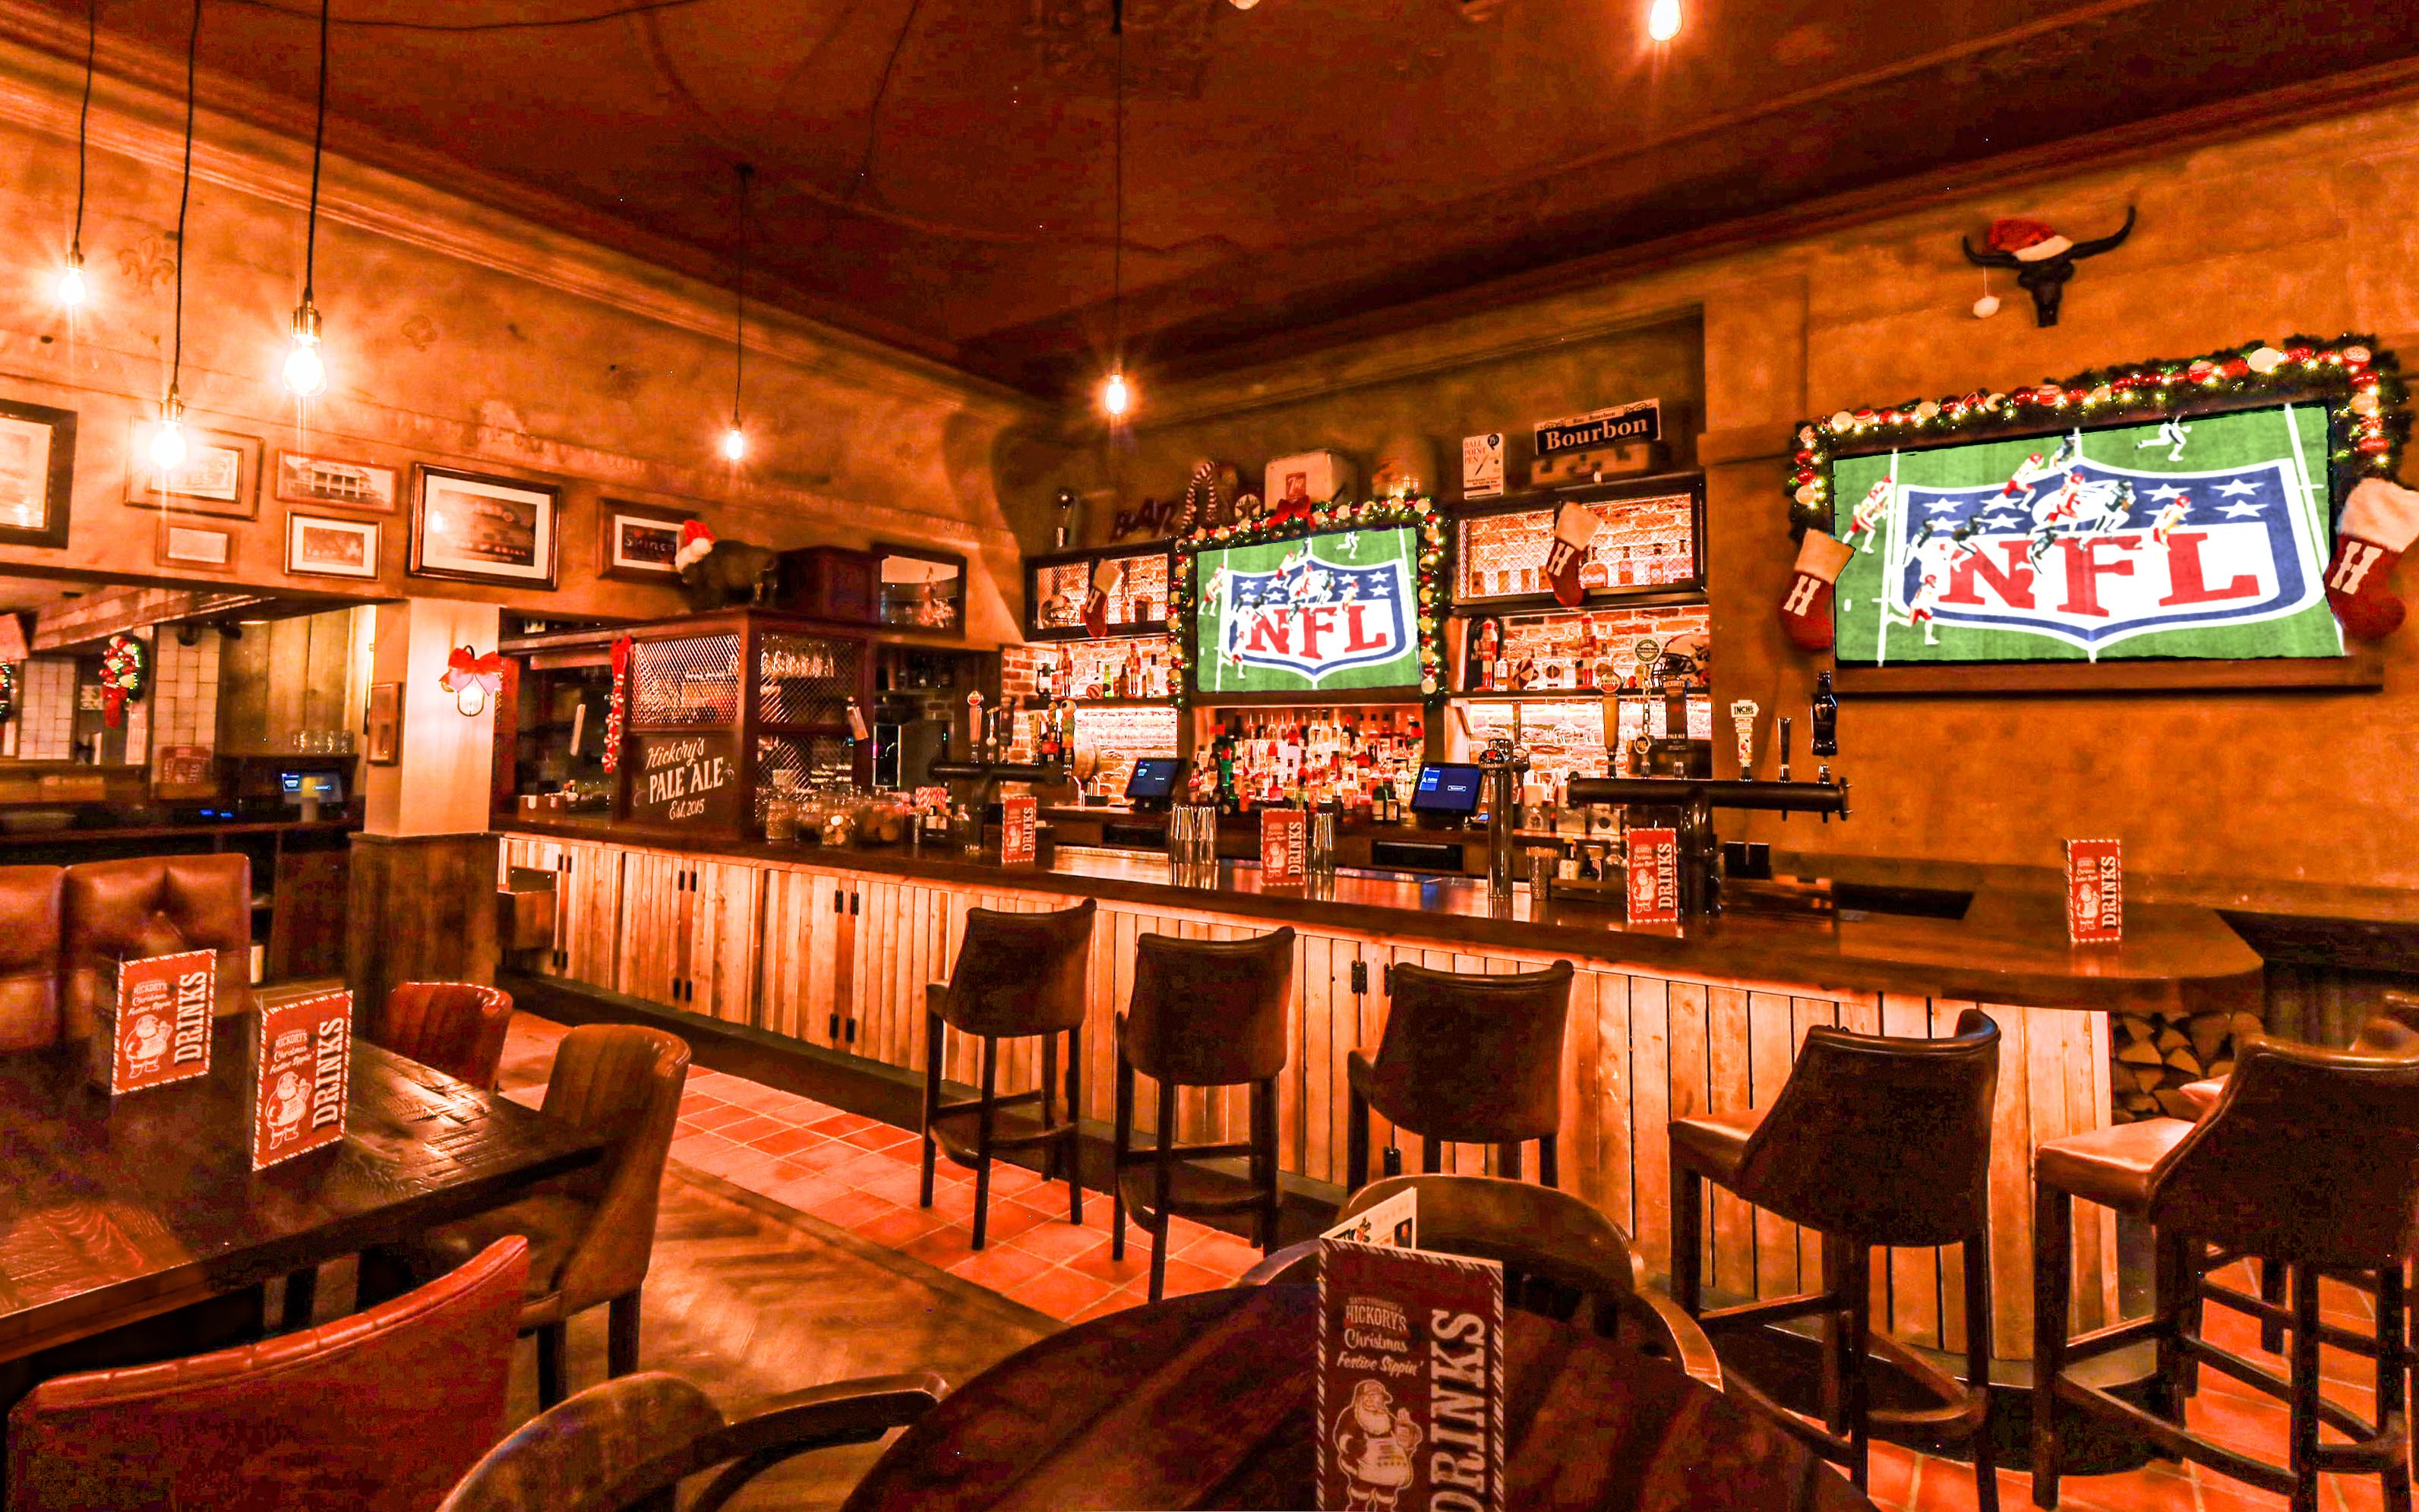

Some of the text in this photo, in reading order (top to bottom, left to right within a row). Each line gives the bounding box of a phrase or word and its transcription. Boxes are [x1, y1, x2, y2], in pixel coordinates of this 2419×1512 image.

[1464, 440, 1481, 448] BALL
[1464, 447, 1486, 456] POINT
[1545, 418, 1649, 450] Bourbon
[1547, 542, 1575, 576] H
[1938, 532, 2260, 617] NFL
[2330, 541, 2383, 595] H
[1783, 575, 1821, 617] H
[1246, 605, 1387, 660] NFL
[646, 737, 705, 770] Hickory's
[649, 756, 724, 804] PALE ALE
[669, 798, 705, 820] Est. 2015
[1022, 807, 1034, 852] DRINKS
[1288, 822, 1303, 875] DRINKS
[1658, 843, 1674, 909] DRINKS
[2101, 856, 2117, 926] DRINKS
[175, 971, 207, 1064] DRINKS
[312, 1017, 344, 1130] DRINKS
[1344, 1327, 1408, 1353] Christmas
[1346, 1305, 1407, 1333] HICKORY'S
[1337, 1351, 1378, 1371] Festive
